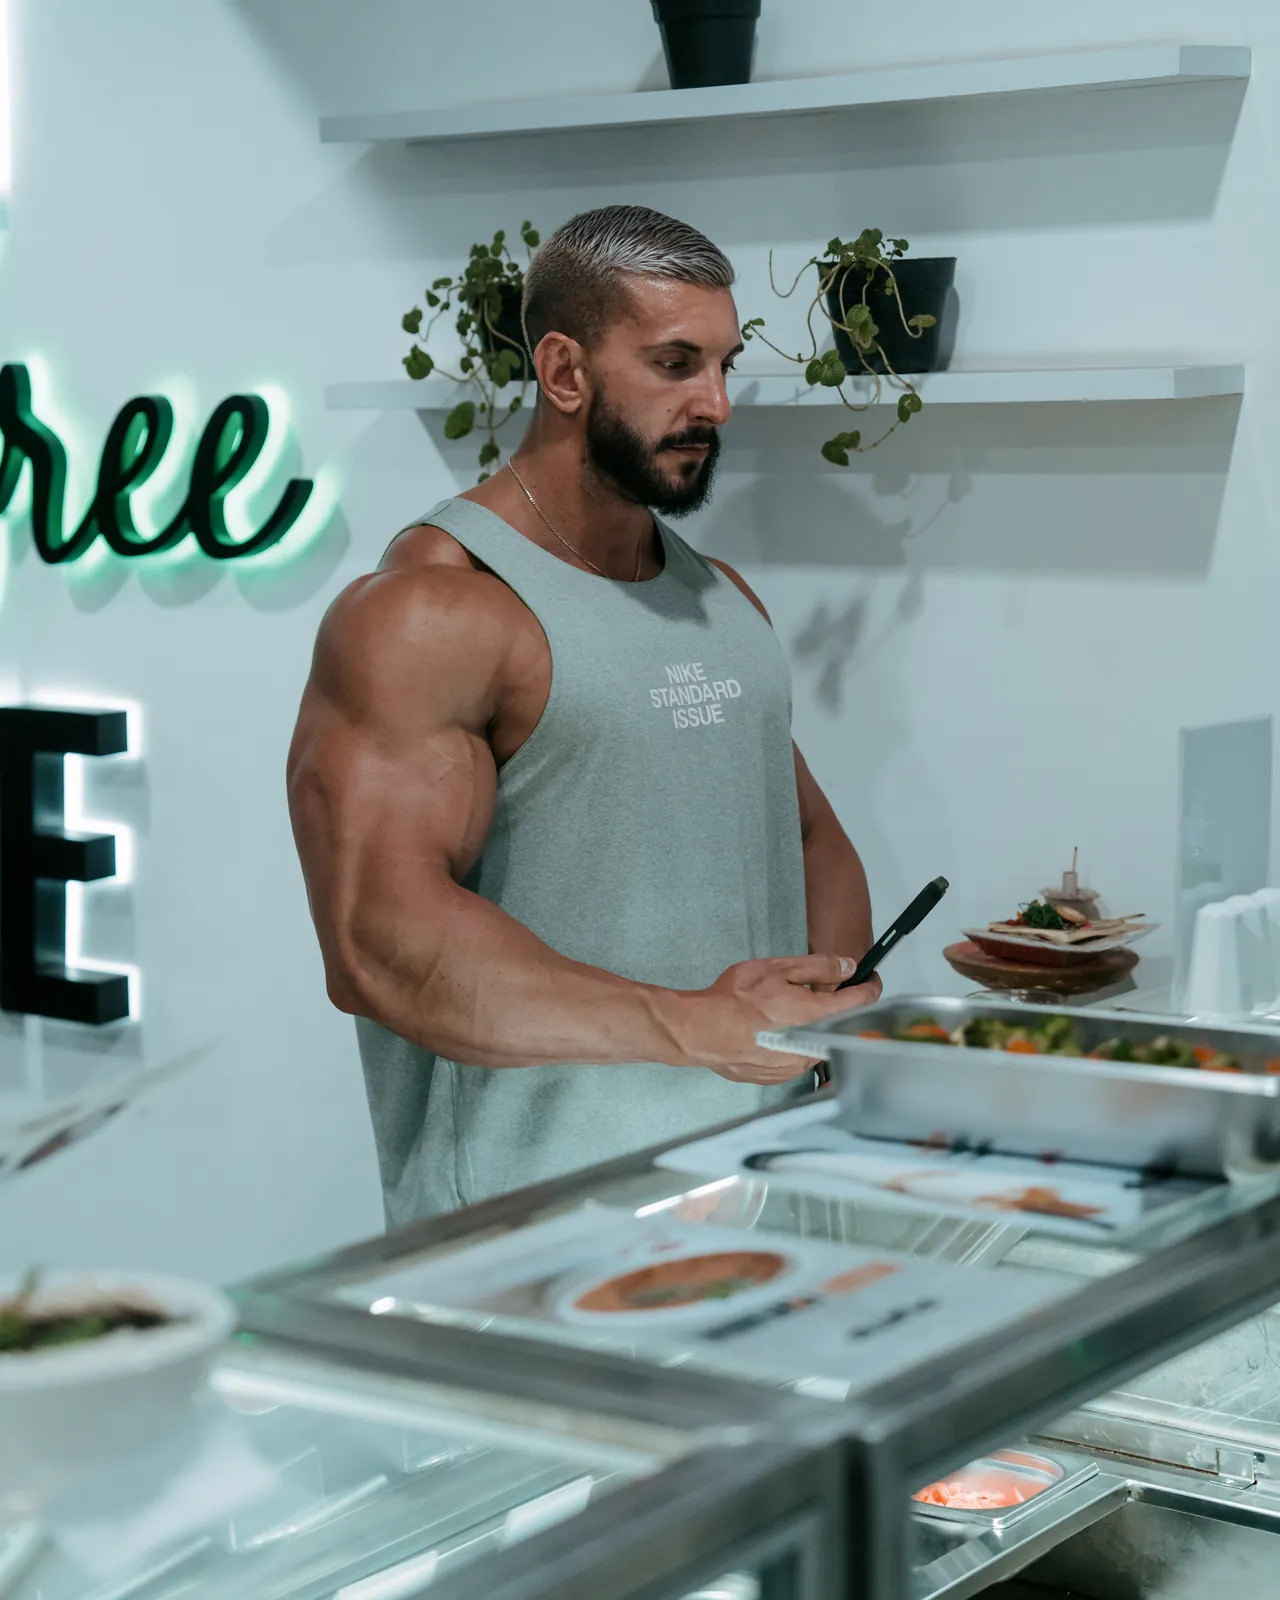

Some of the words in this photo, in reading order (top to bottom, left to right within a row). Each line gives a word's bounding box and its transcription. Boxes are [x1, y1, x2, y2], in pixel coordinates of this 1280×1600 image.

[664, 662, 708, 684] NIKE
[649, 679, 742, 708] STANDARD
[672, 704, 725, 729] ISSUE
[0, 707, 129, 1025] E
